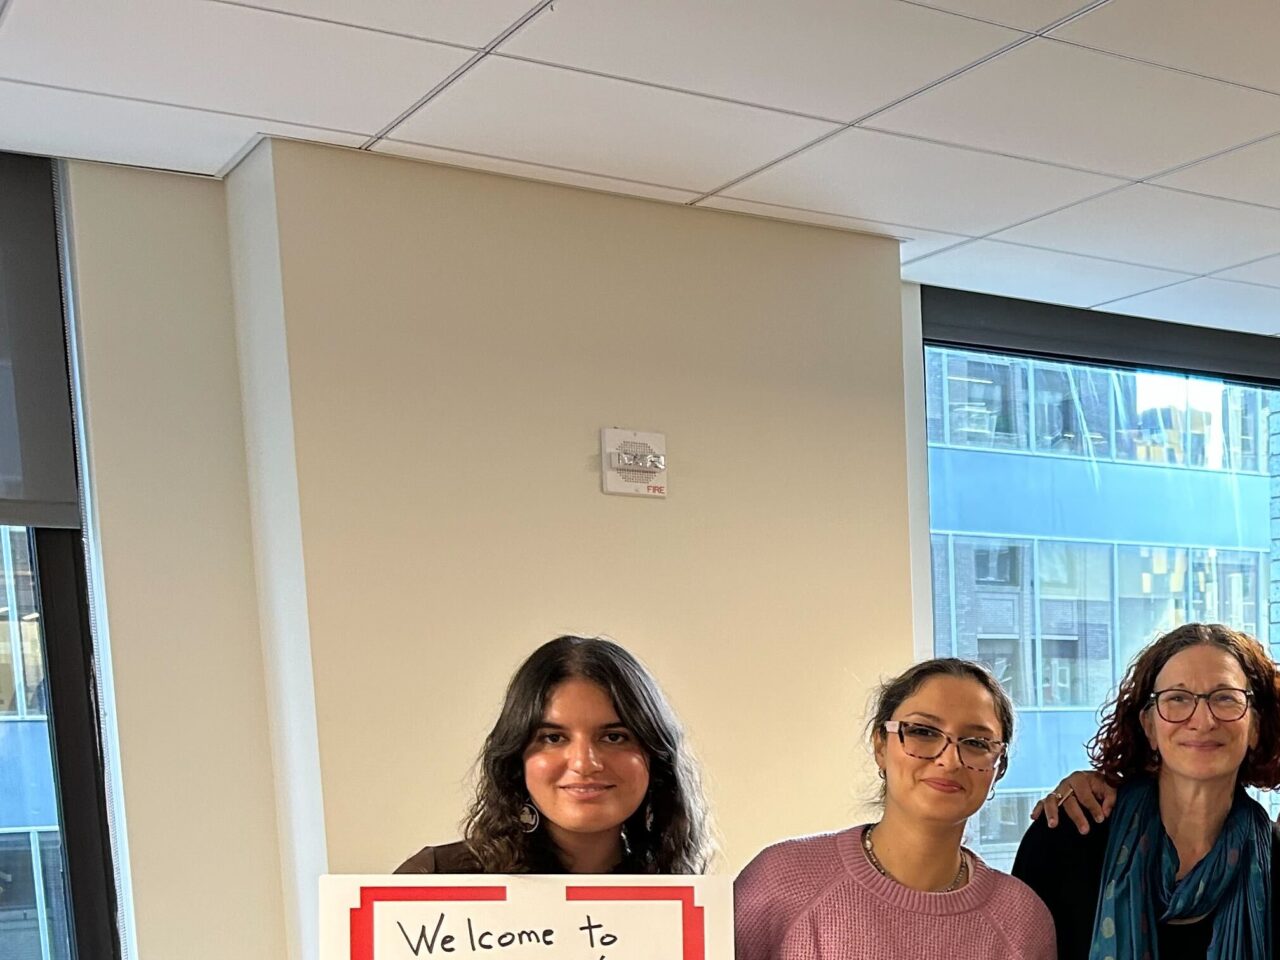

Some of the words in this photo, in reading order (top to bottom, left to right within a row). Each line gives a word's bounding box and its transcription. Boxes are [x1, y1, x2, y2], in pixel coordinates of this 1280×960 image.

[646, 485, 665, 495] FIRE
[396, 913, 555, 956] Welcome
[579, 914, 619, 949] to
